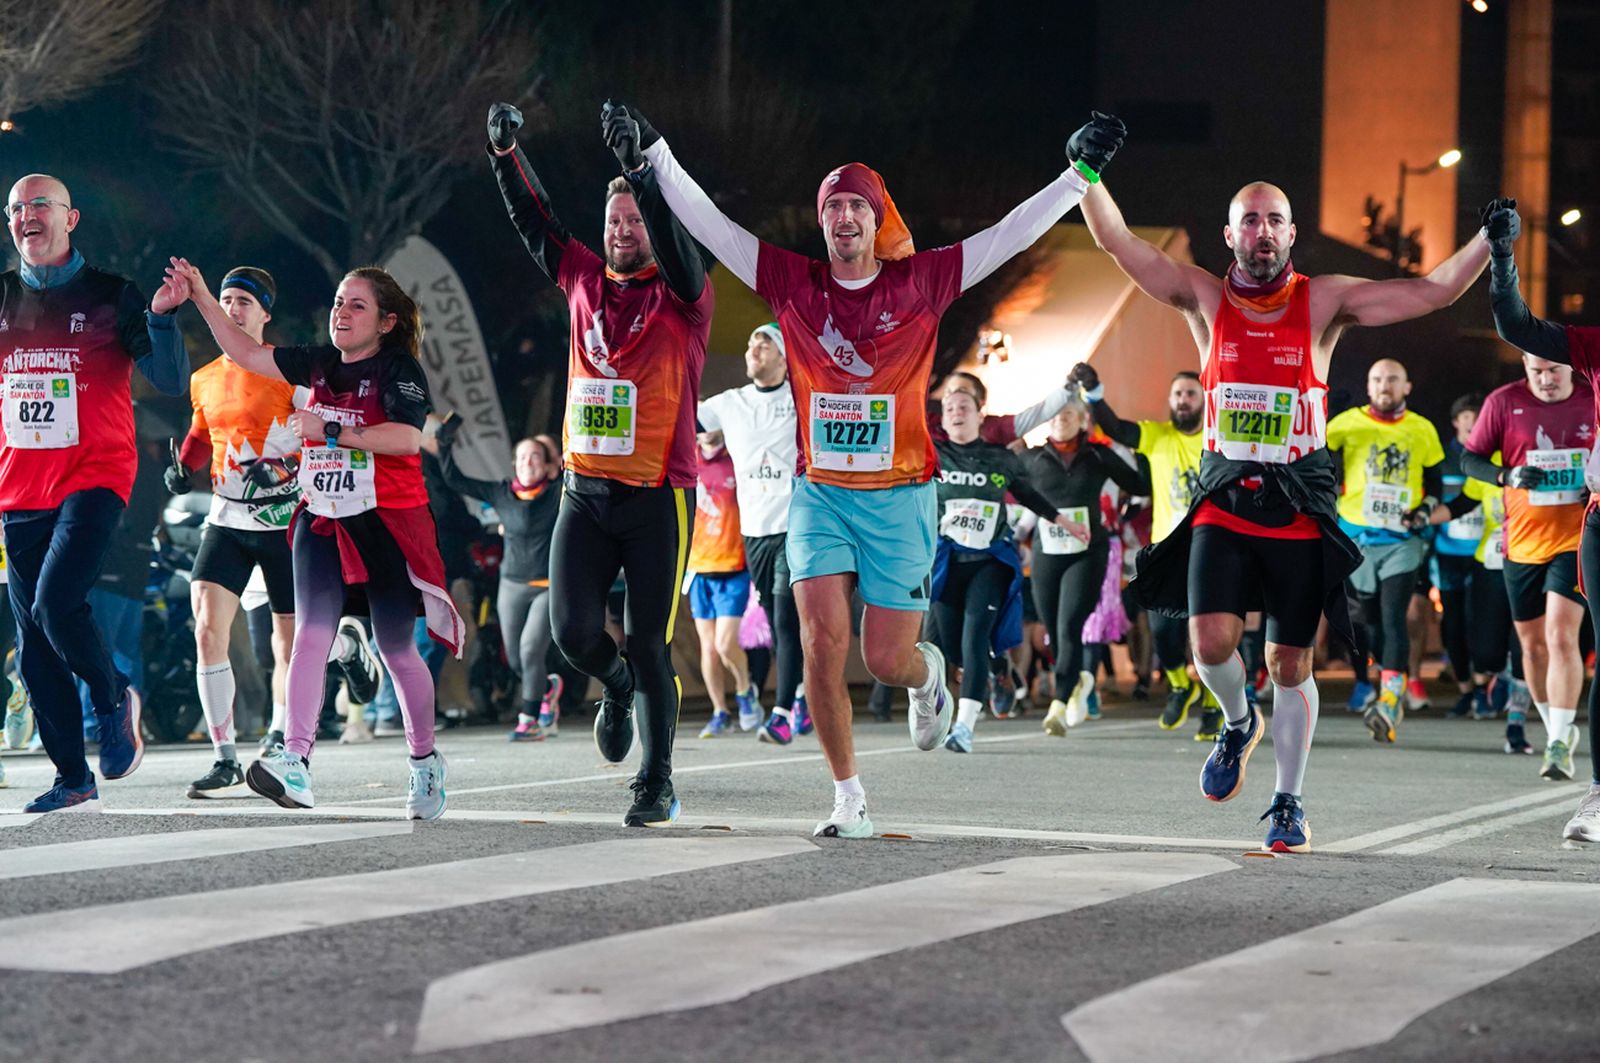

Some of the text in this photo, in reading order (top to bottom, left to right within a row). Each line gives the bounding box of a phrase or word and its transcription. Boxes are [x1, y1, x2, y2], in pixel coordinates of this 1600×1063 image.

[431, 273, 503, 441] JAPEMASA
[833, 345, 855, 367] 43
[826, 402, 851, 411] NOCHE
[852, 403, 862, 412] DE
[1224, 401, 1240, 410] SAN
[1233, 392, 1268, 402] NOCHE DE
[19, 401, 55, 422] 822
[819, 410, 834, 419] SAN
[823, 421, 881, 445] 12727
[1229, 411, 1282, 437] 12211
[313, 470, 356, 492] 6774
[951, 514, 986, 532] 2836
